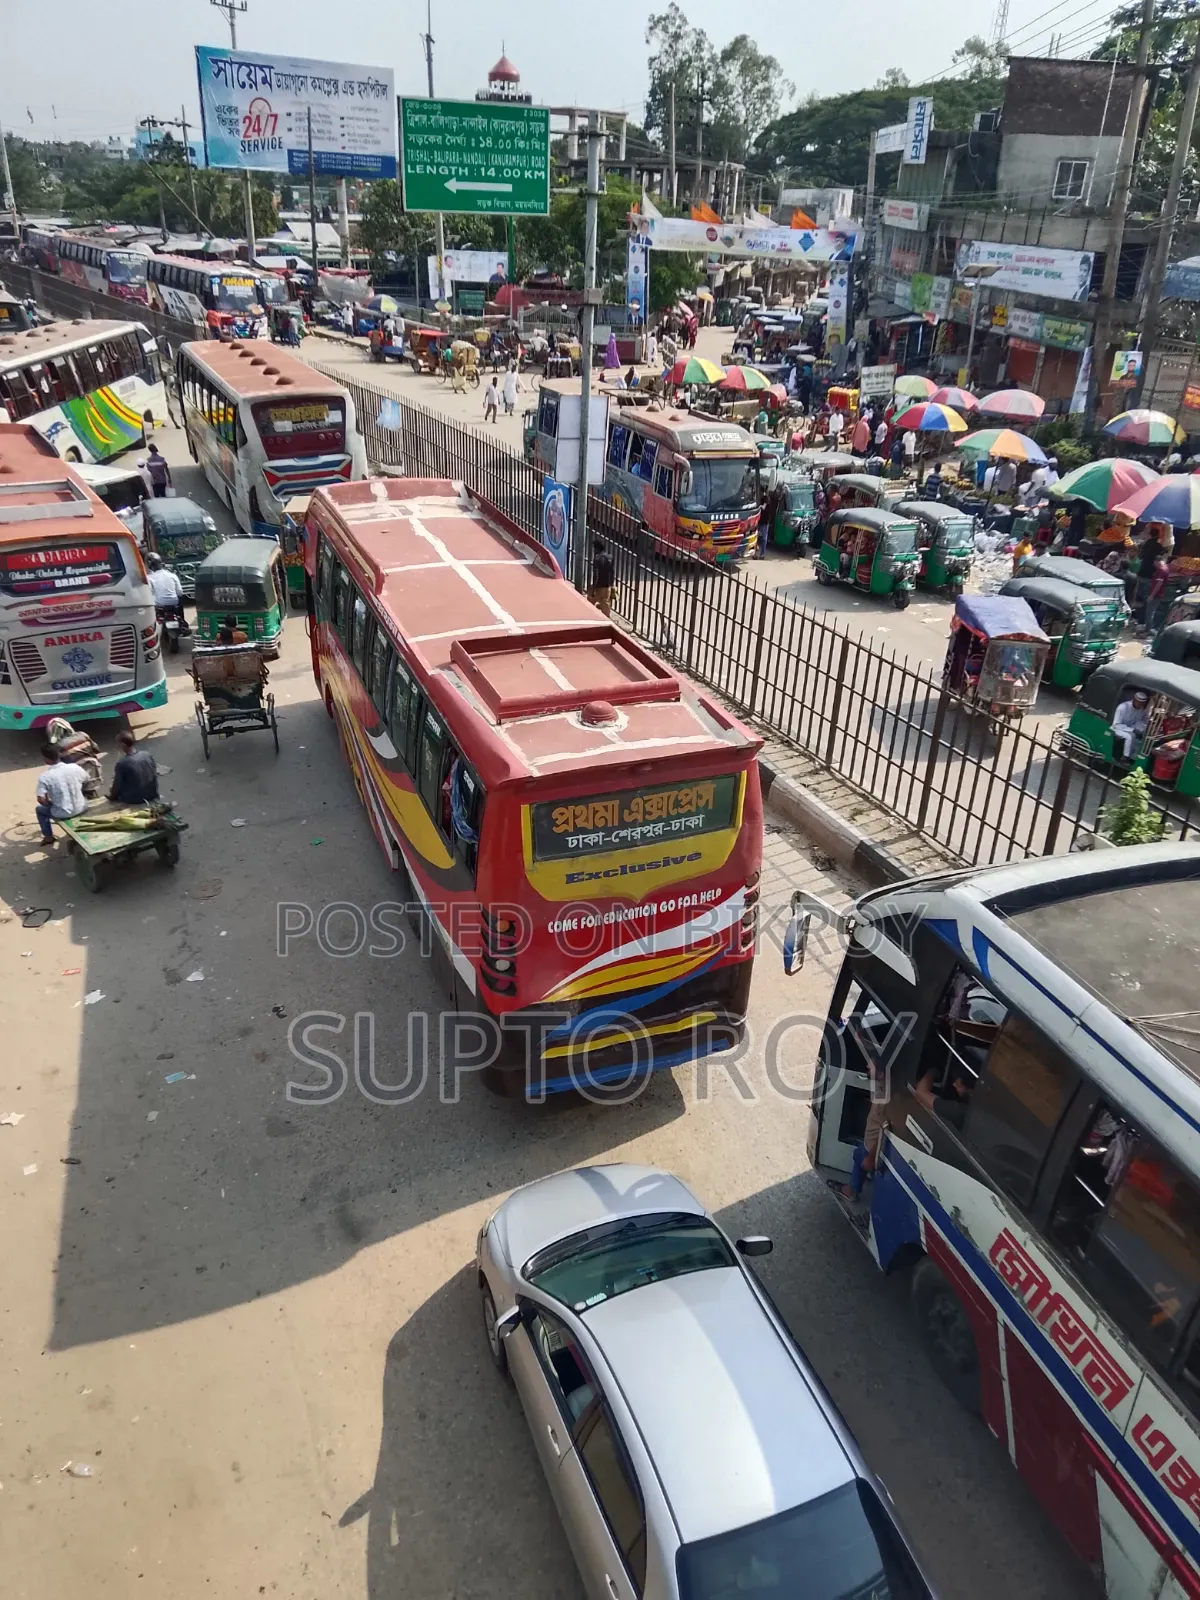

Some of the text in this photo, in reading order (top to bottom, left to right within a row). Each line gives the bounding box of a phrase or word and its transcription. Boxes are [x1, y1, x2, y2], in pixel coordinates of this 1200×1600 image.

[208, 57, 275, 94] সায়েম
[242, 114, 278, 139] 24/7
[240, 137, 283, 153] SERVICE
[407, 133, 443, 147] সড়কের
[531, 155, 546, 169] ROAD
[407, 164, 469, 176] LENGTH
[525, 169, 546, 180] KM
[54, 576, 90, 588] BRAND
[44, 631, 104, 647] ANIKA
[51, 674, 112, 690] EXCLUSIVE
[552, 783, 716, 834] প্রথমা এক্সপ্রেস
[565, 851, 702, 884] Exclusive
[547, 917, 578, 934] COME
[603, 903, 658, 925] EDUCATION
[659, 899, 675, 913] GO
[677, 894, 698, 909] FOR
[700, 887, 722, 904] HELP
